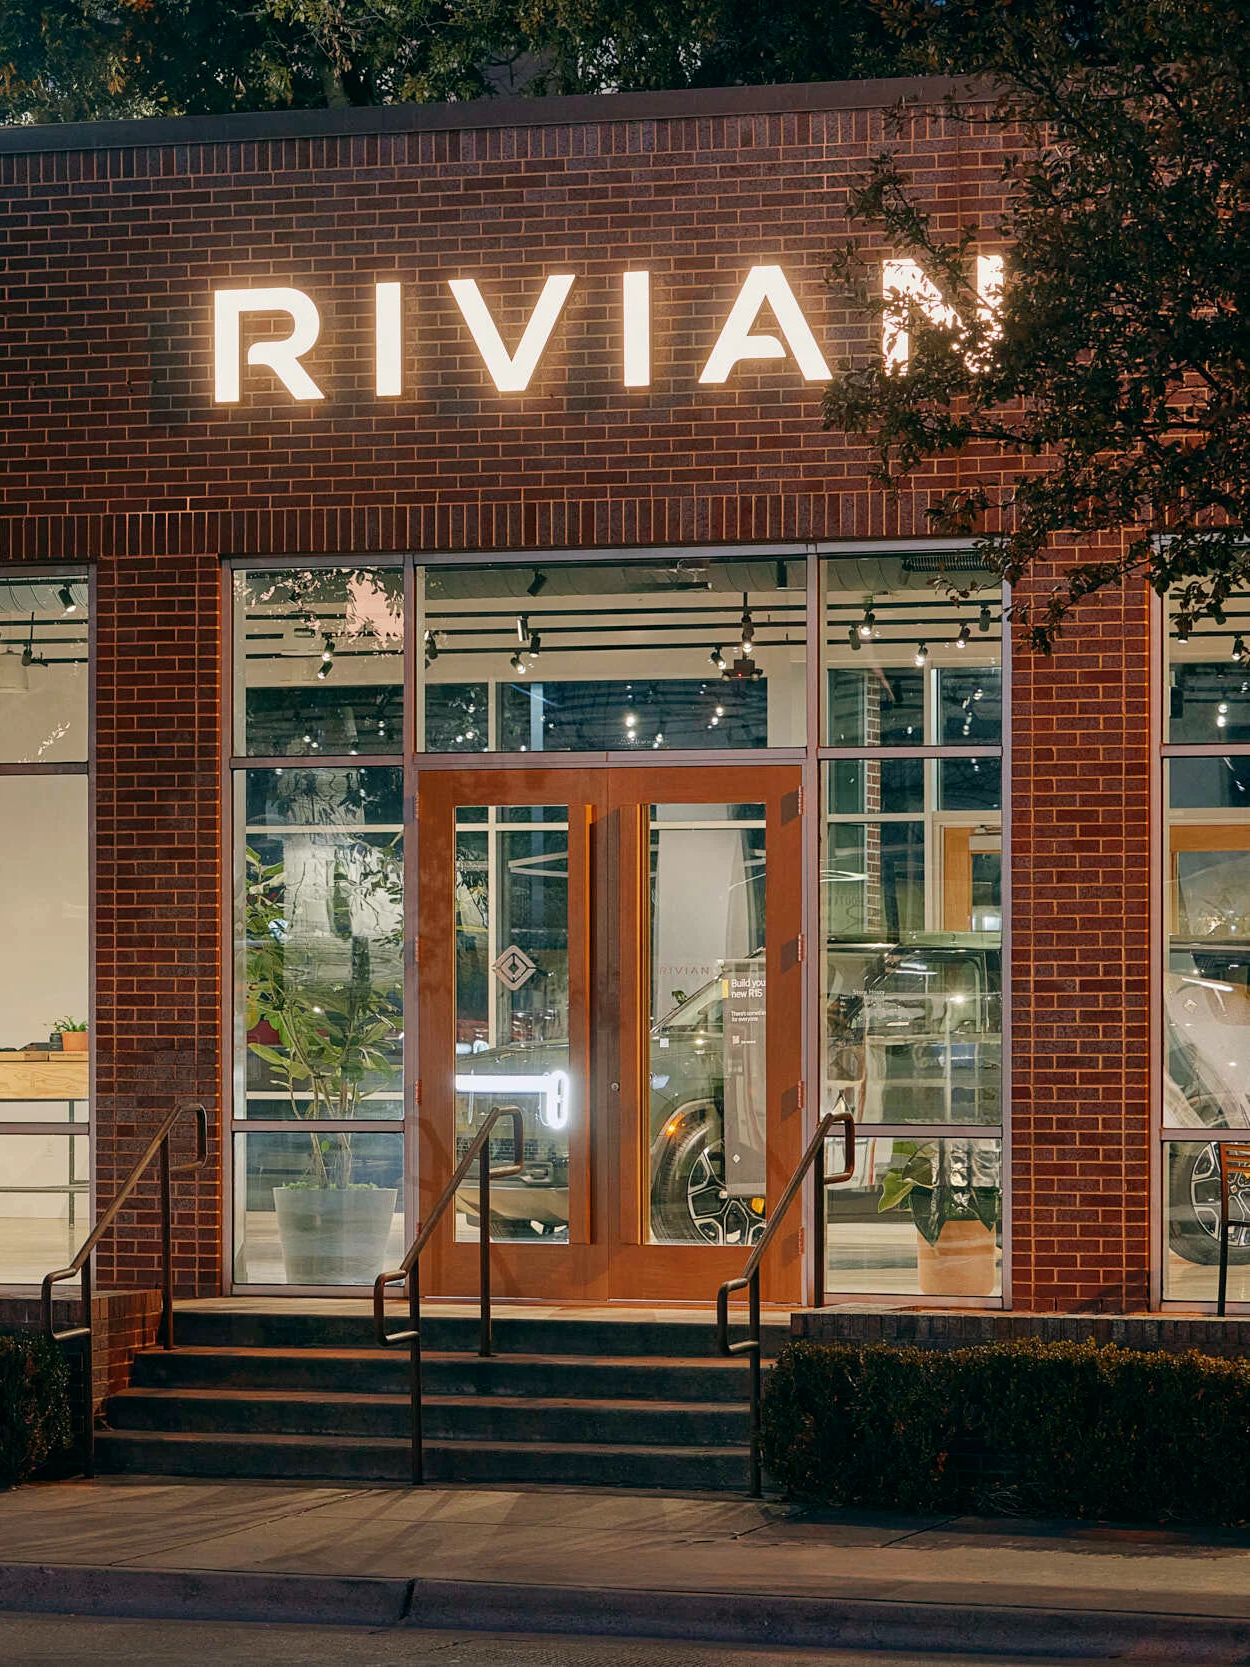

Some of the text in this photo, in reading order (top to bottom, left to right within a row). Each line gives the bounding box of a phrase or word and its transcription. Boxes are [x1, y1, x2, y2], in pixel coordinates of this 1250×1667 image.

[214, 255, 1004, 403] RIVIAN
[659, 966, 710, 976] RIVIAN
[731, 979, 766, 988] Build you
